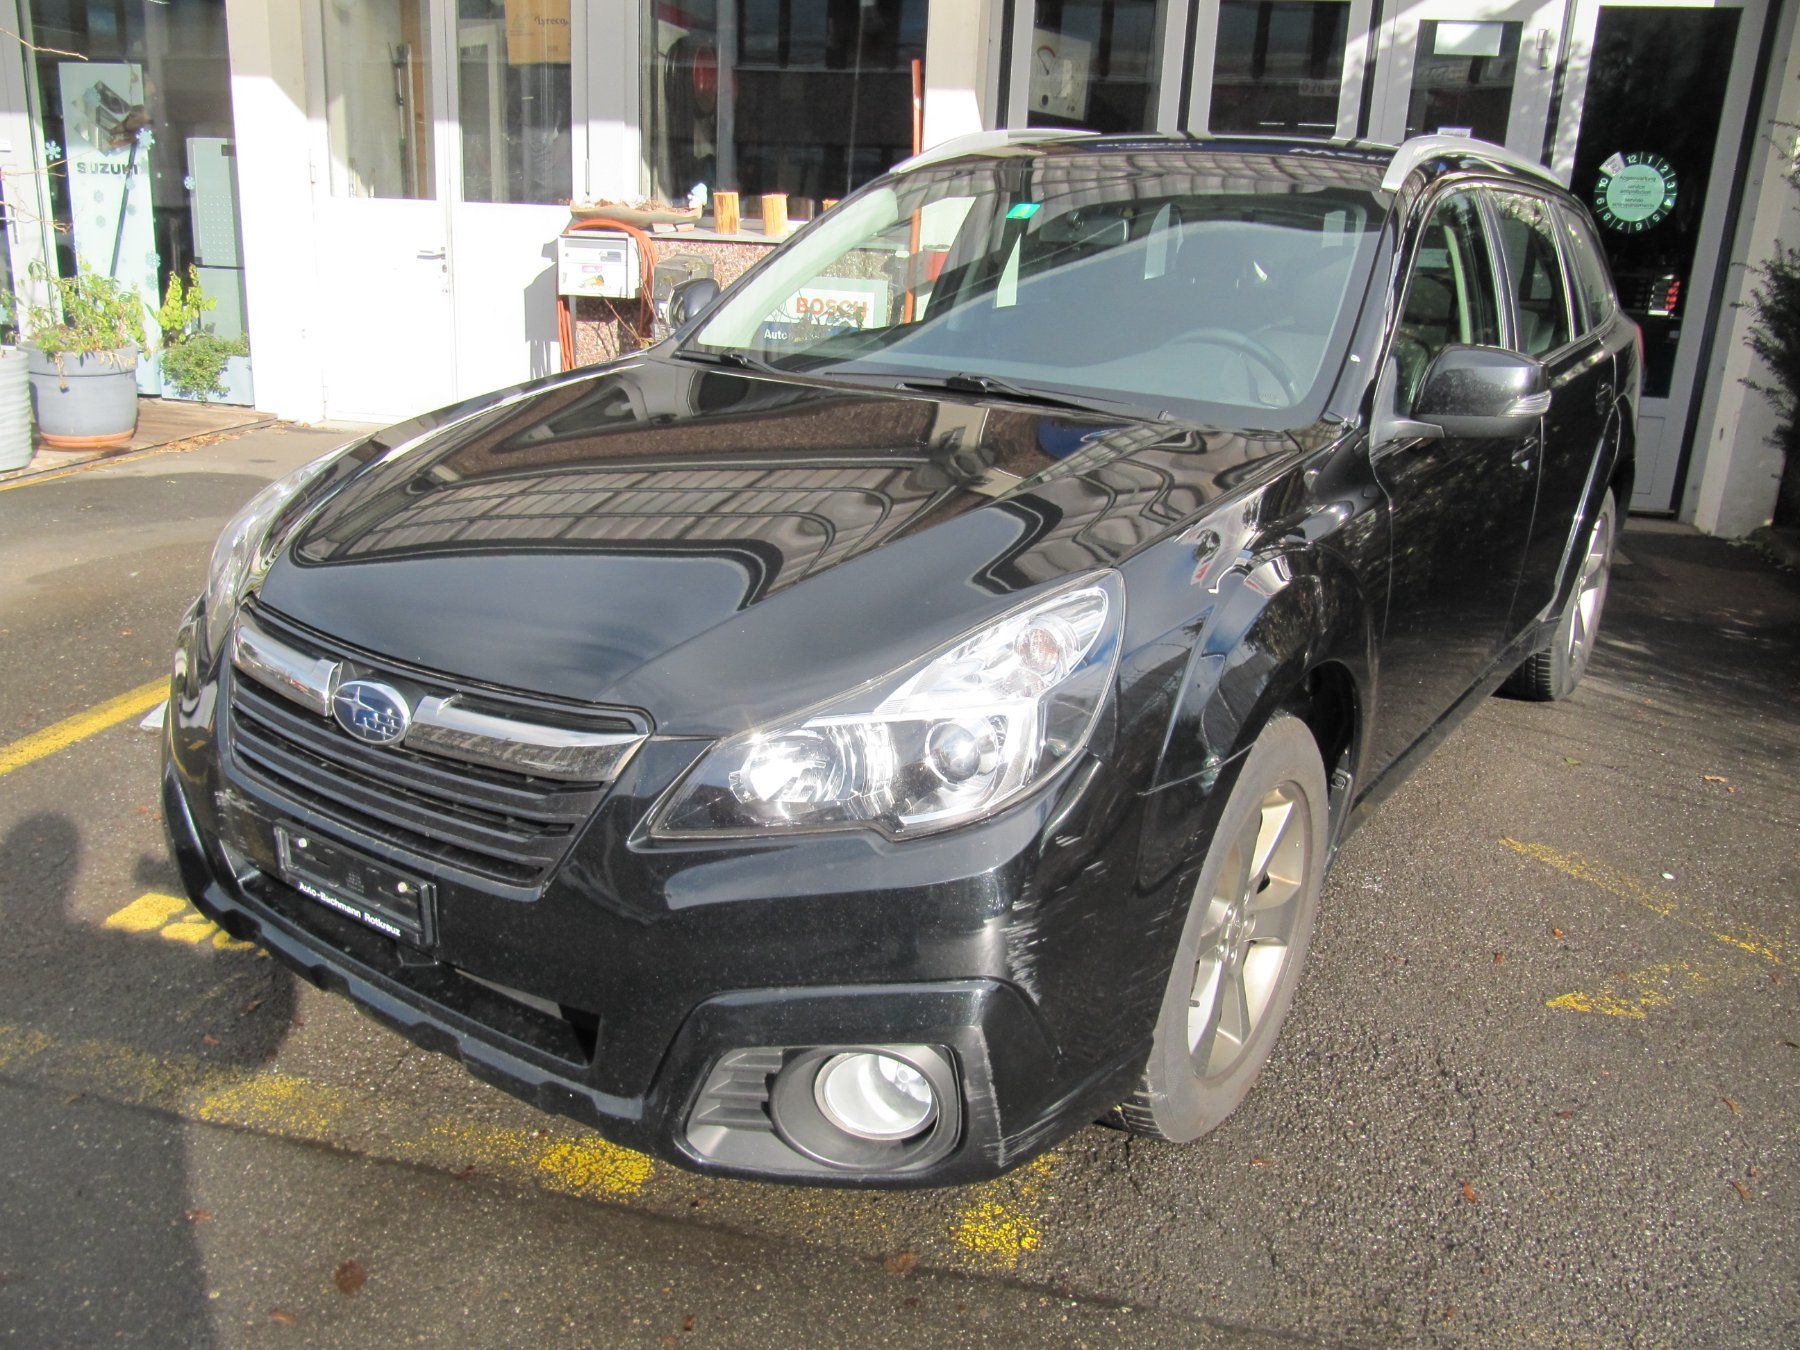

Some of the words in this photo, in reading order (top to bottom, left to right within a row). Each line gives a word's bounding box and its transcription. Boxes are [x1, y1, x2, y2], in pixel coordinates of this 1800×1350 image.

[1626, 154, 1637, 164] 12
[1647, 154, 1653, 164] 1
[1660, 165, 1669, 173] 2
[1598, 178, 1609, 188] 10
[1666, 181, 1676, 189] 3
[1603, 212, 1611, 220] 8
[796, 297, 867, 318] BOSCH
[363, 912, 401, 937] Rotkreuz
